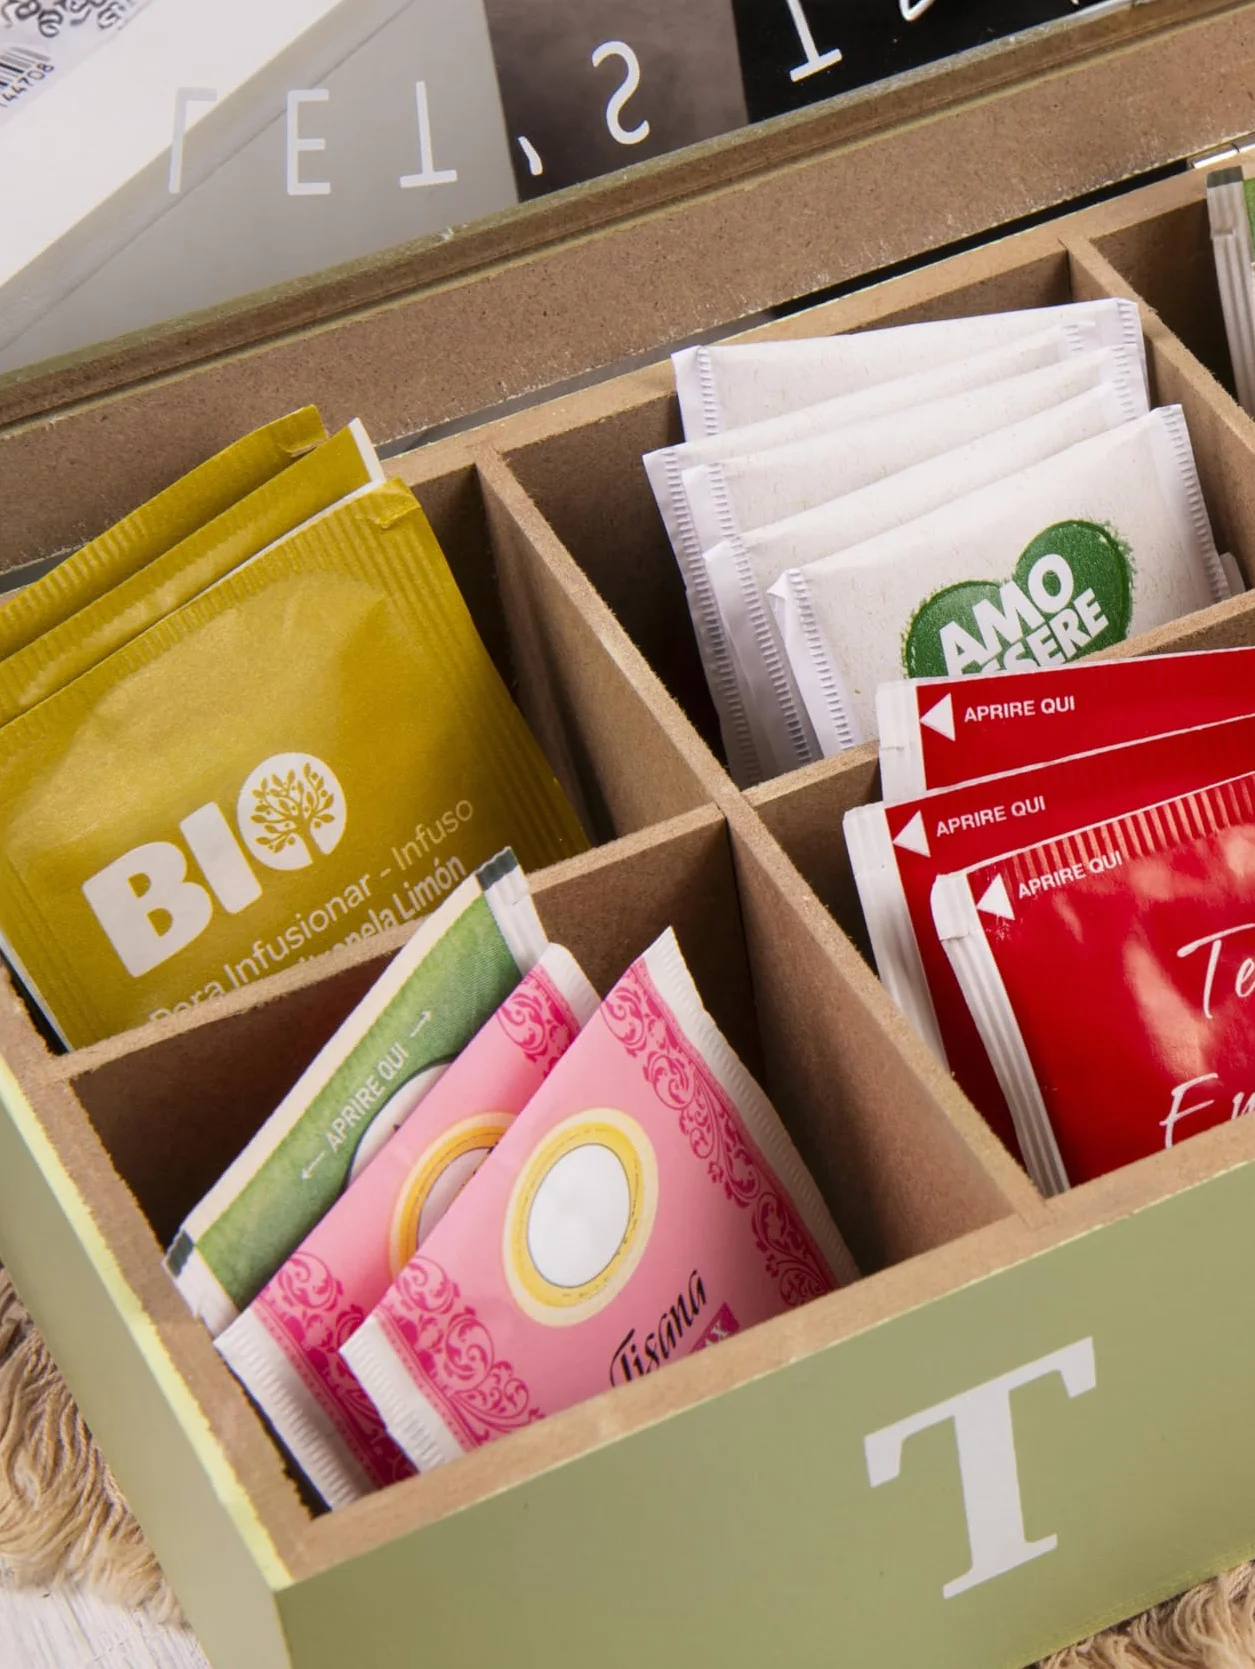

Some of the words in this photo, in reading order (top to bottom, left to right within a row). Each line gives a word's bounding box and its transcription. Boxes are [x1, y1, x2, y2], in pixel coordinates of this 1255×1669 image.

[939, 553, 1075, 676] AMO
[981, 588, 1109, 671] SERE
[964, 700, 1035, 723] APRIRE
[1040, 695, 1076, 715] QUI
[82, 752, 347, 978] BIO
[936, 805, 1007, 838] APRIRE
[1011, 795, 1046, 817] QUI
[224, 874, 371, 989] Infusionar
[391, 800, 473, 871] Infuso
[392, 856, 467, 919] Limón
[1018, 863, 1086, 899] APRIRE
[1088, 850, 1123, 873] QUI
[324, 1075, 386, 1153] APRIRE
[376, 1042, 410, 1082] QUI
[609, 1269, 707, 1388] Tisana
